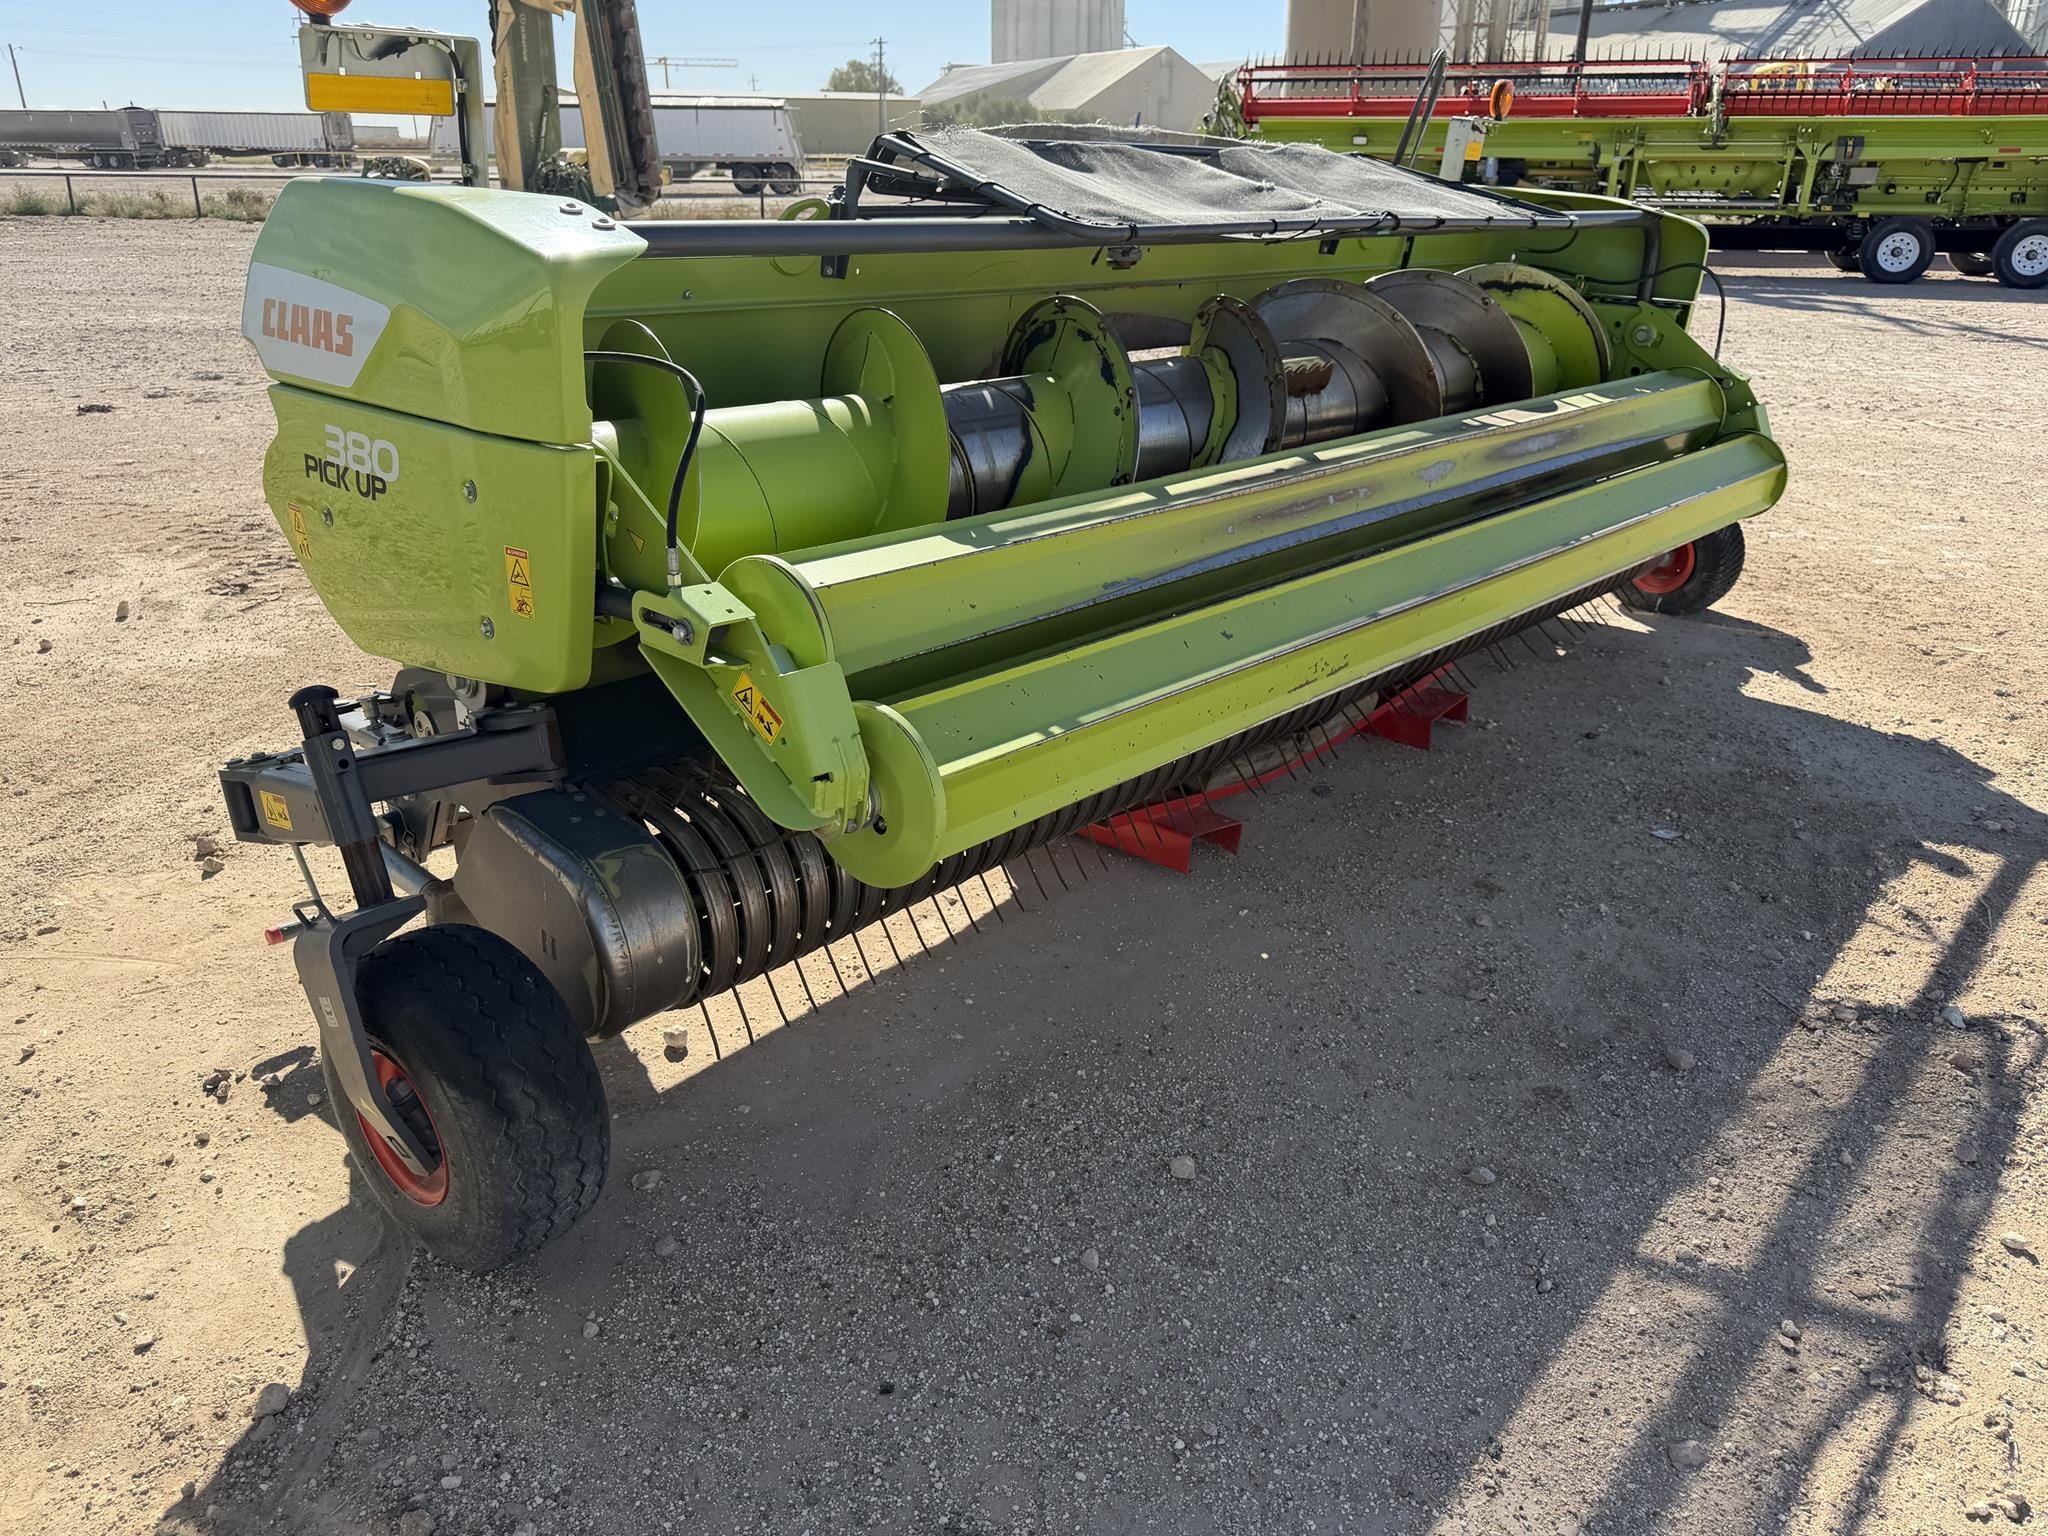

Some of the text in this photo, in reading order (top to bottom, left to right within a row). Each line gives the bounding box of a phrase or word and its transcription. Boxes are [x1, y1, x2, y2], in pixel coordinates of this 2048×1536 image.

[262, 297, 354, 357] CLAAS
[304, 453, 387, 501] PICK UP
[324, 423, 400, 482] 380
